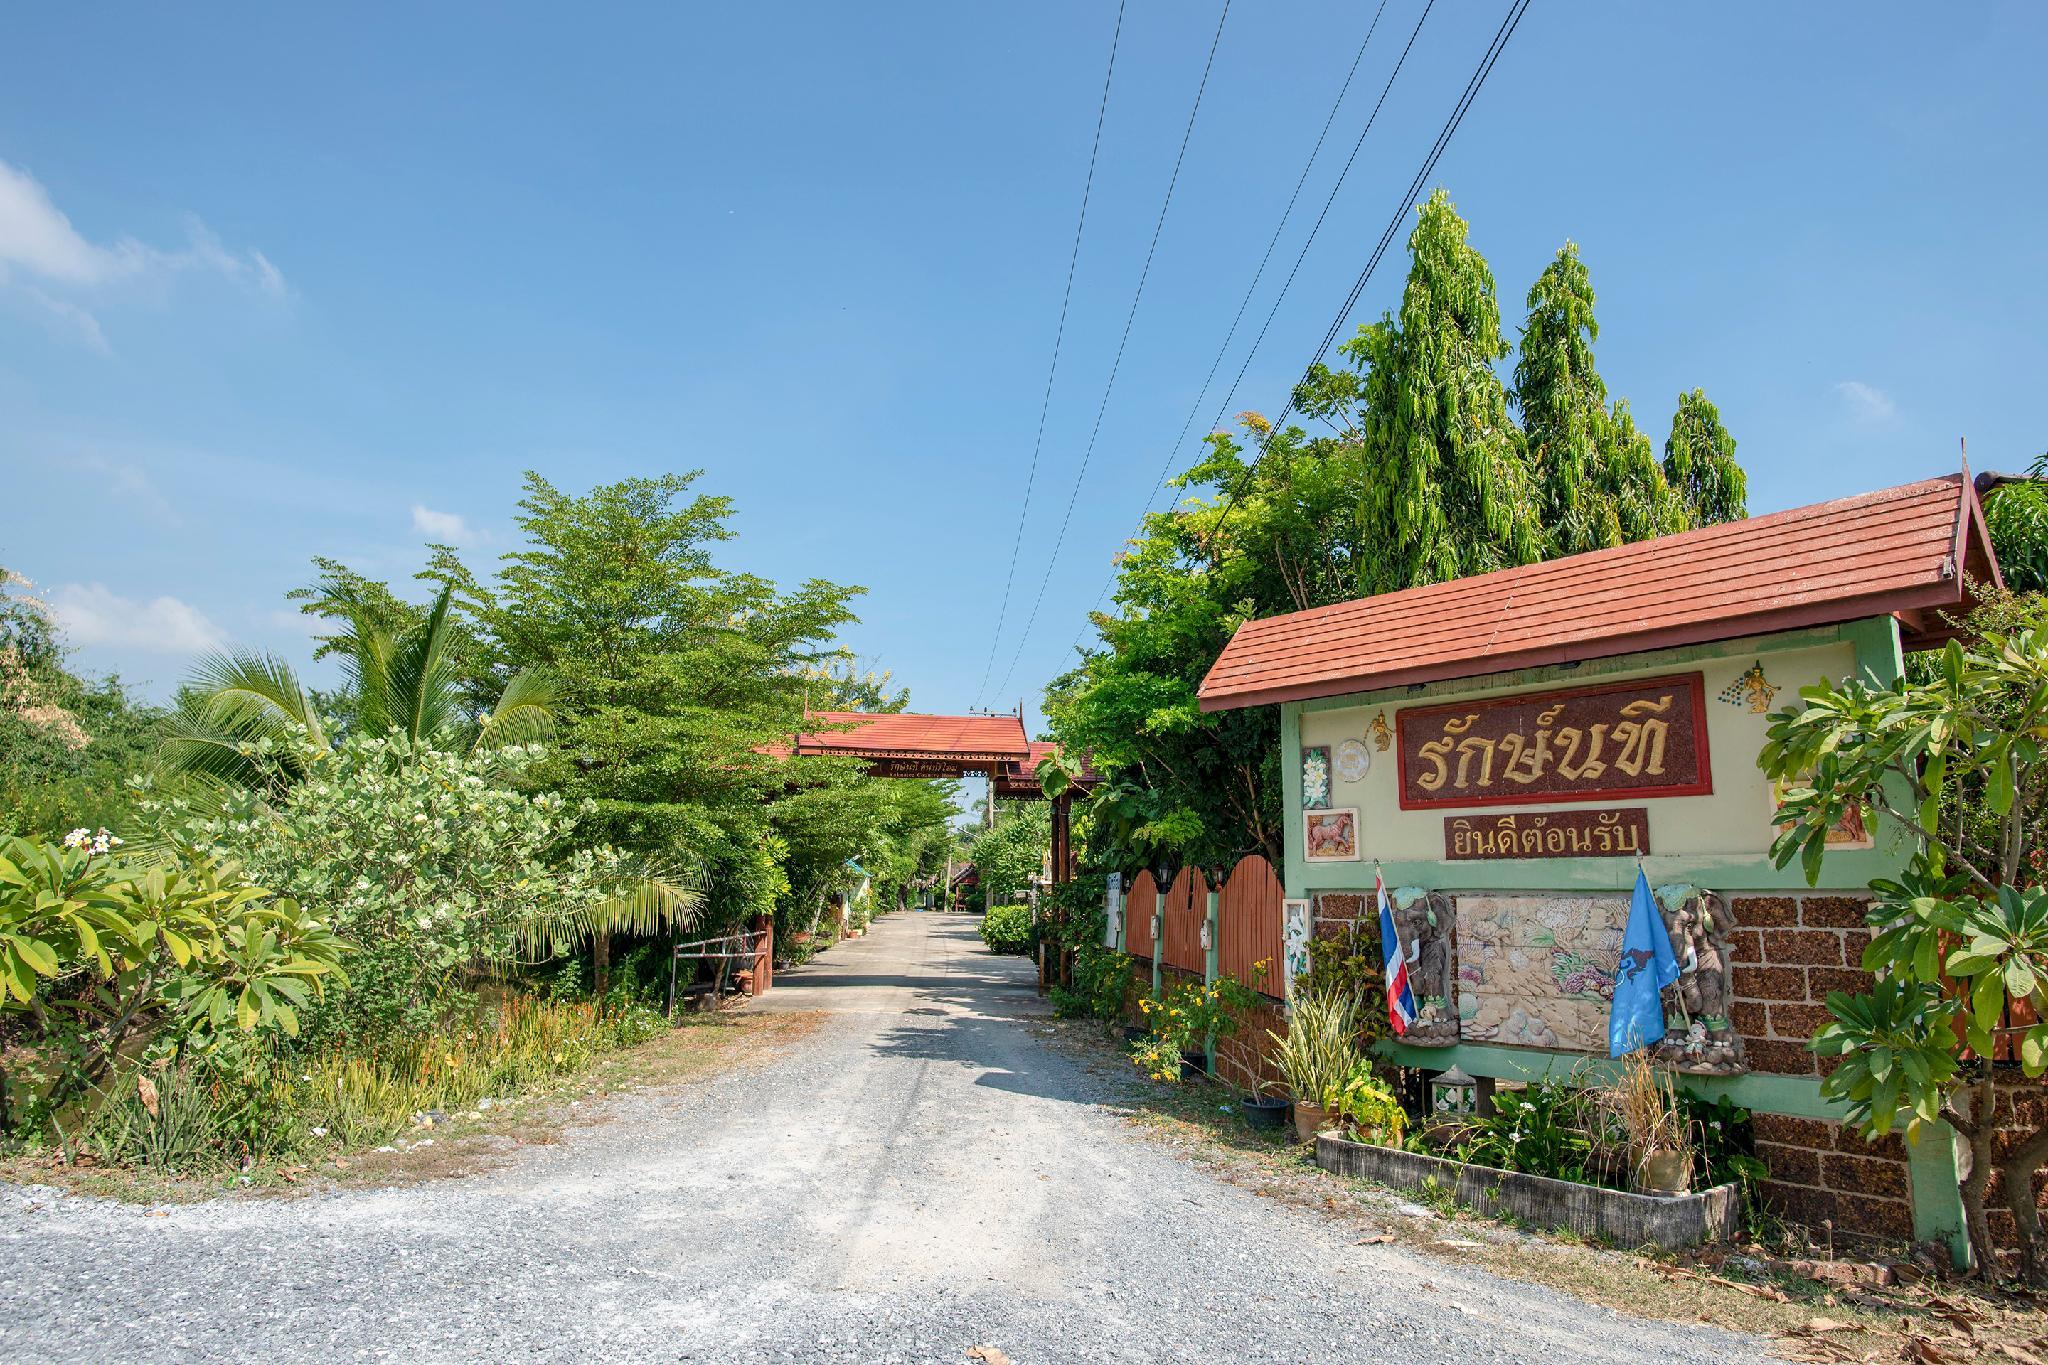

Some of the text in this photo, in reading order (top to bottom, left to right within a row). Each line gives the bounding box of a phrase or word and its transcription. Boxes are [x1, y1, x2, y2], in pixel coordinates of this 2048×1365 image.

[1416, 695, 1674, 791] รักษ์นที
[1453, 813, 1640, 855] ยินดีต้อนรับ
